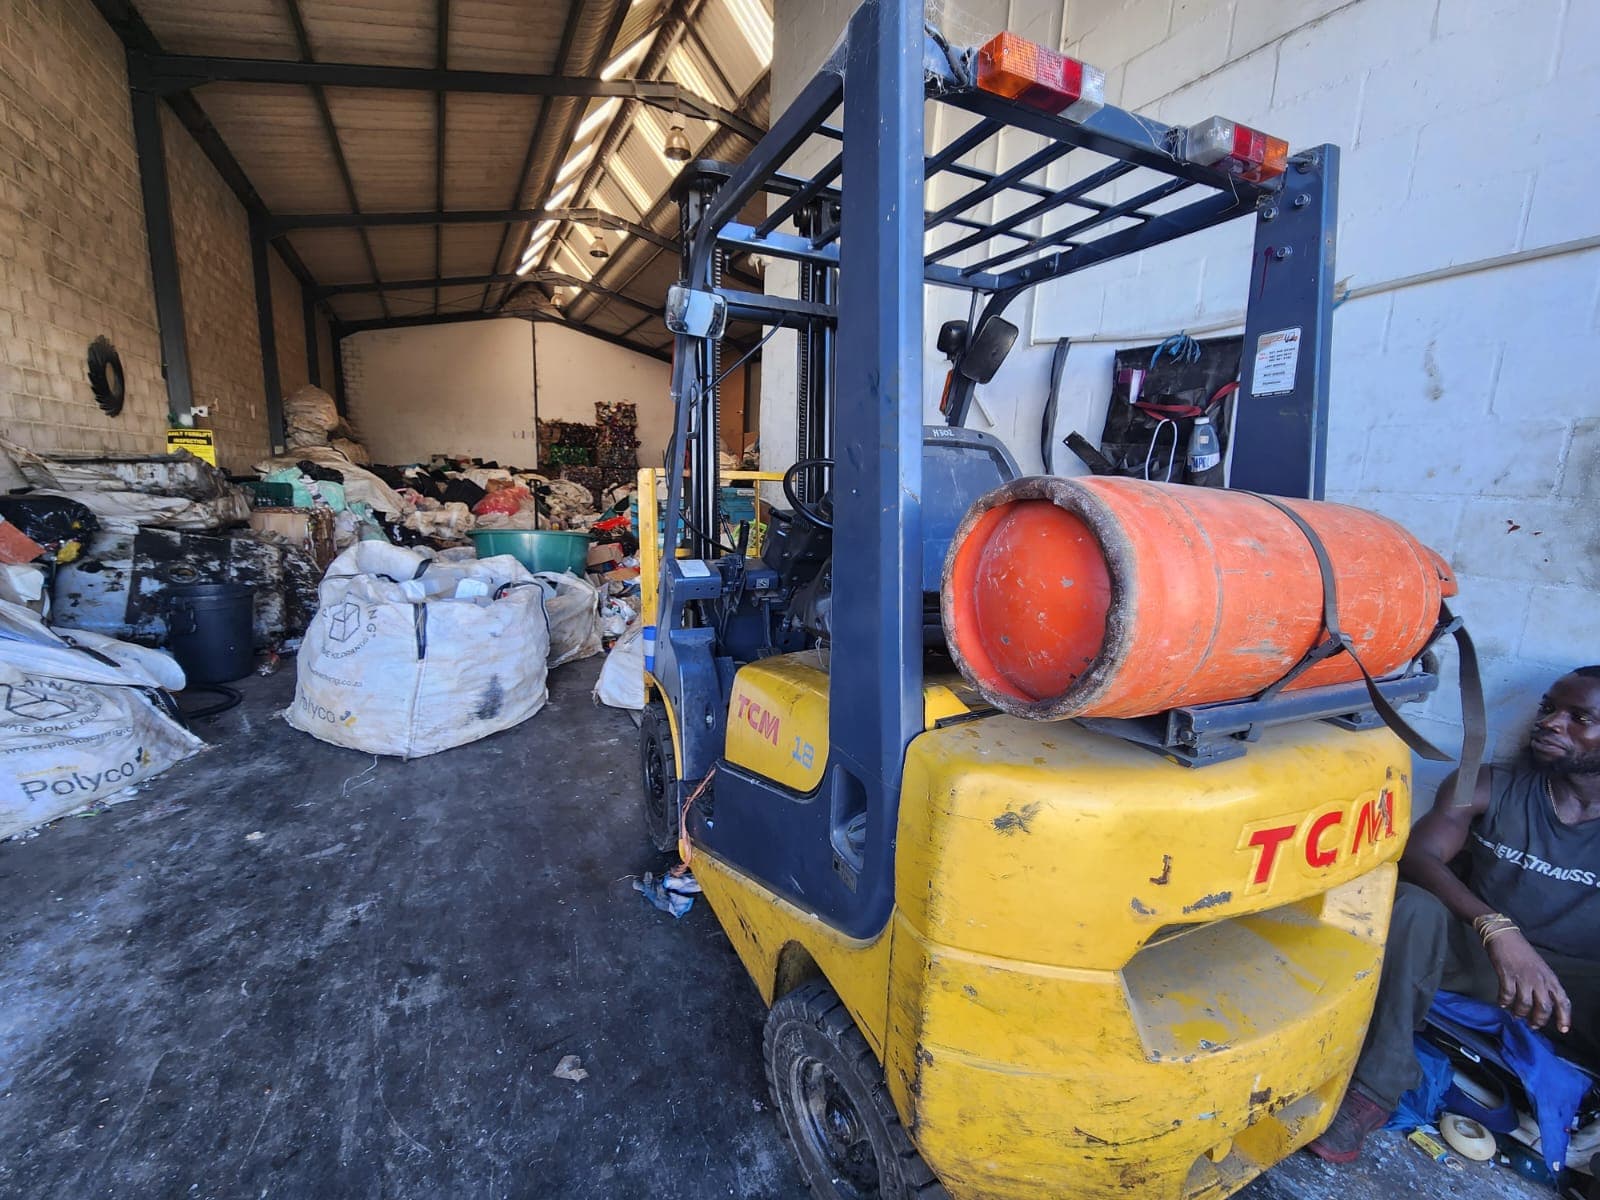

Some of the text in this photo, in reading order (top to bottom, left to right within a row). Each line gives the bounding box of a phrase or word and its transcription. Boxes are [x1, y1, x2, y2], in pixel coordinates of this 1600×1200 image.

[738, 694, 780, 746] TCM
[792, 736, 815, 769] 18
[19, 761, 134, 802] Polyco
[1248, 789, 1396, 885] TCM
